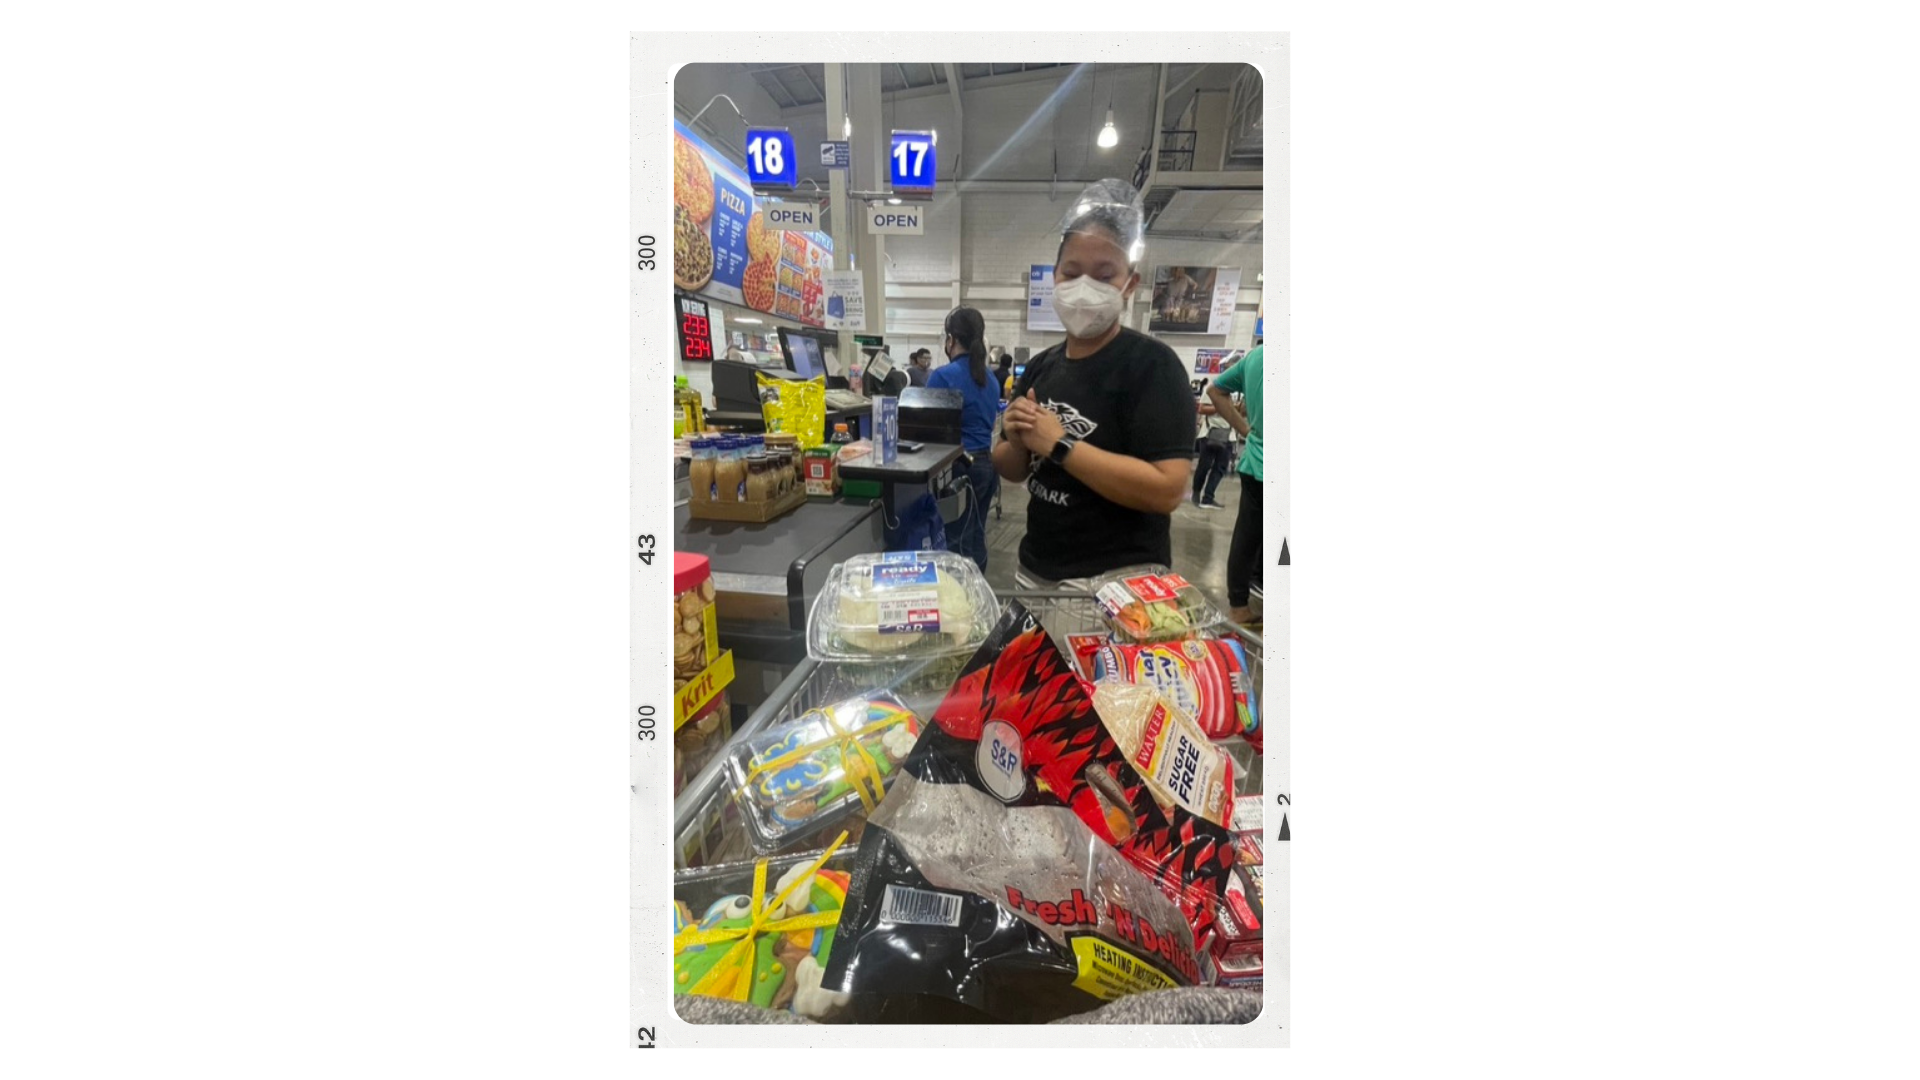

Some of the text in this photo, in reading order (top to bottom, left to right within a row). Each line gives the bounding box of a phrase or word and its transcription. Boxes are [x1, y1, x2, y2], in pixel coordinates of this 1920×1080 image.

[748, 137, 784, 175] 18
[893, 141, 928, 177] 17
[720, 187, 746, 216] PIZZA
[770, 210, 813, 224] OPEN
[874, 214, 918, 227] OPEN
[683, 313, 708, 336] 233
[686, 337, 711, 358] 234
[882, 565, 928, 575] ready
[682, 672, 714, 717] Krit
[1139, 708, 1164, 765] WALTER
[991, 739, 1017, 773] S&R
[1168, 735, 1189, 792] SUGAR
[1178, 743, 1201, 804] FREE
[1005, 884, 1097, 926] Fresh
[1093, 942, 1132, 975] HEATING
